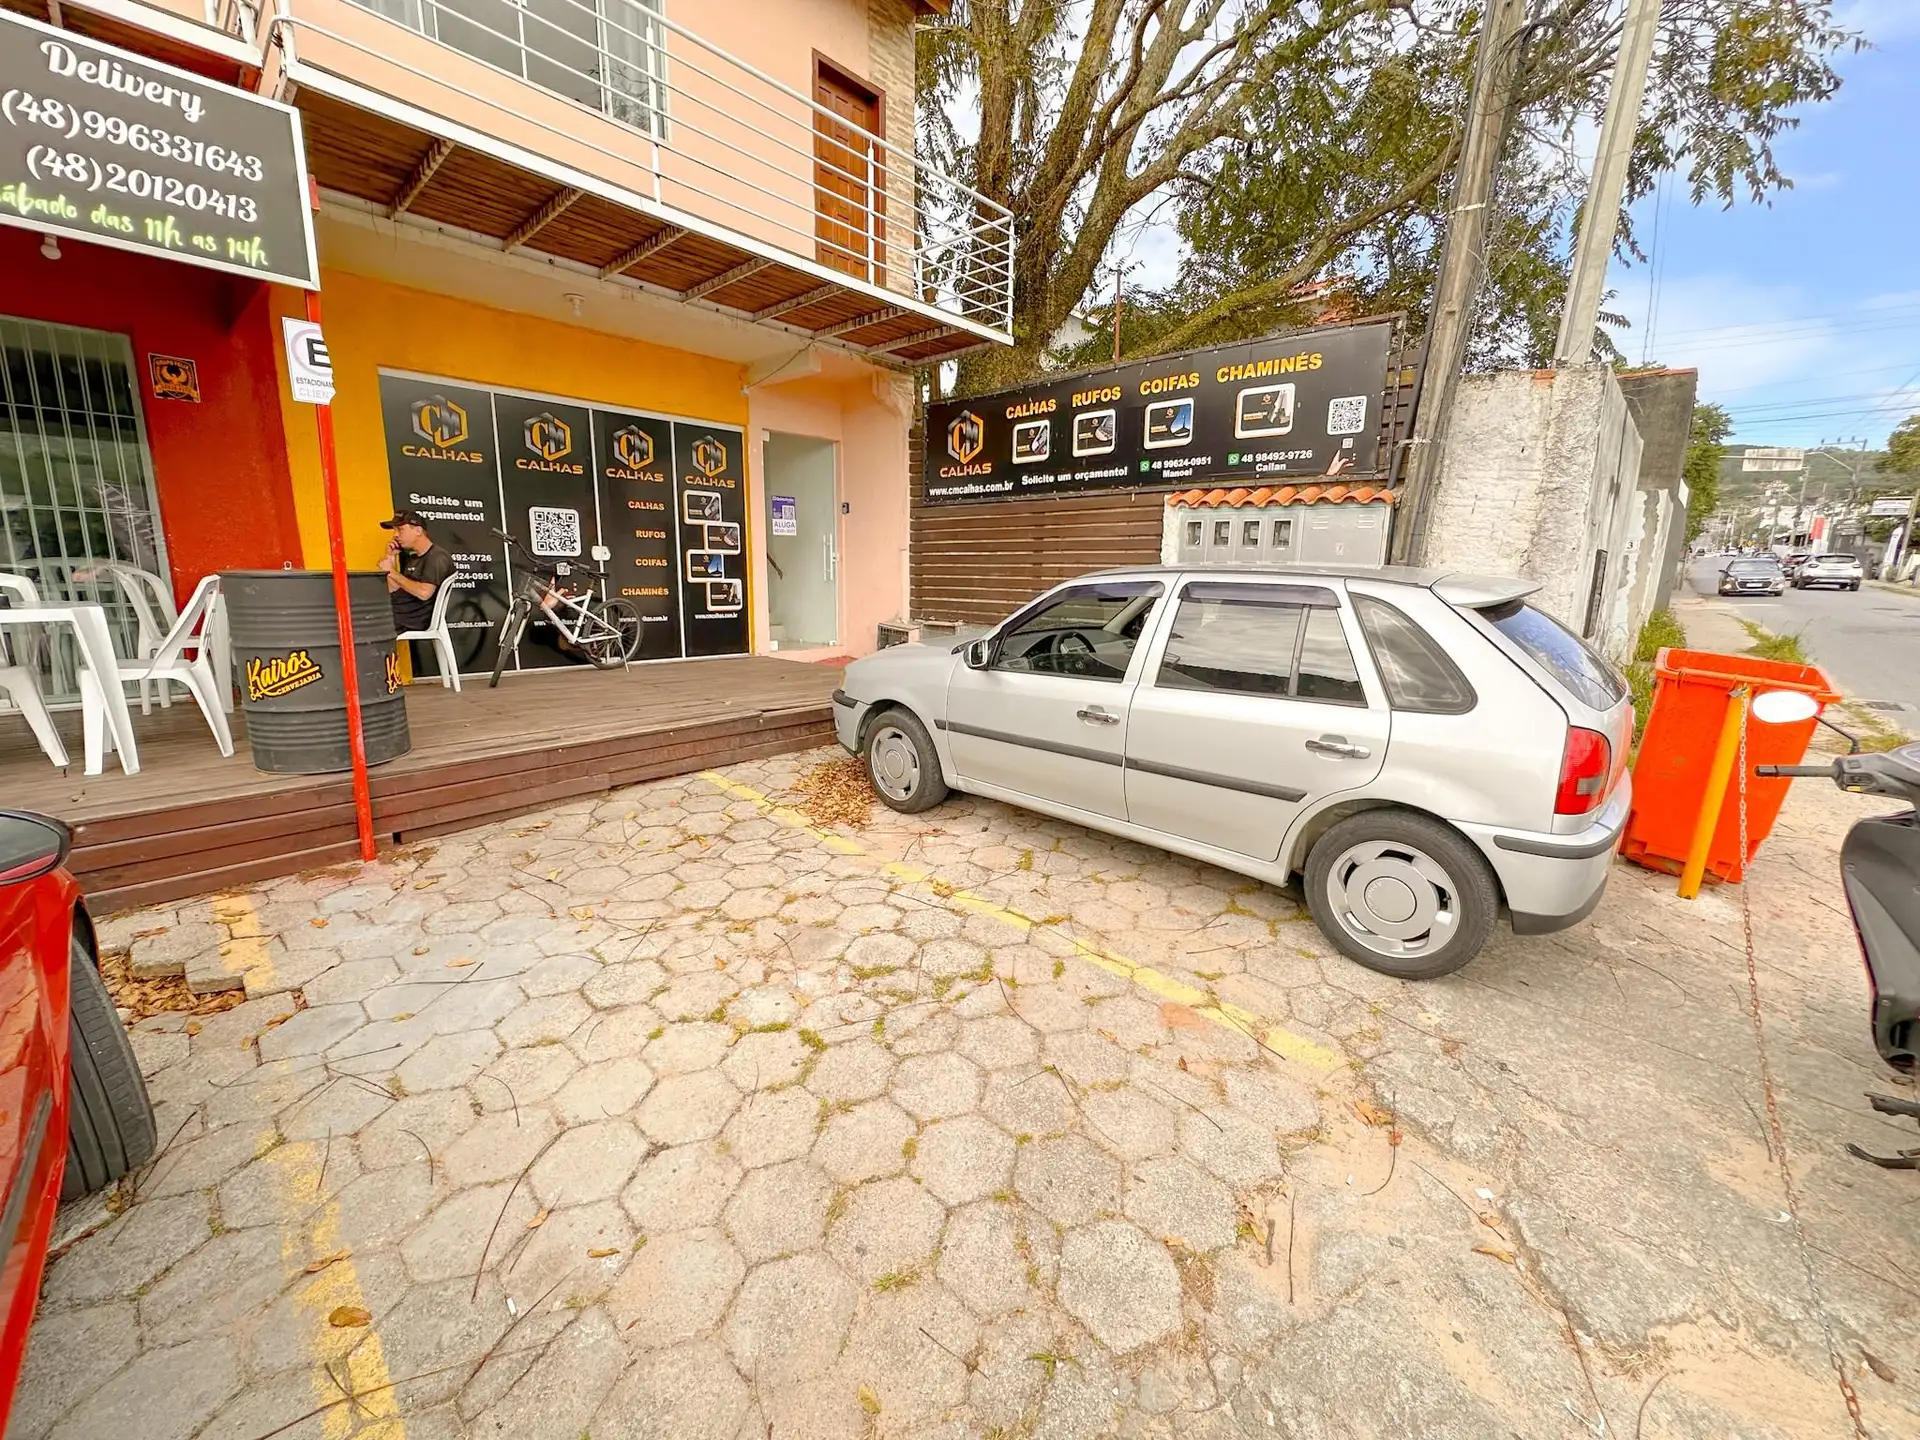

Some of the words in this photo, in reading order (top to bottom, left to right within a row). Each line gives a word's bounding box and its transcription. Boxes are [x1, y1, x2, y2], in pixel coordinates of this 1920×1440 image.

[40, 41, 206, 123] Delivery
[1, 89, 263, 182] (48)996331643
[26, 145, 258, 223] (48)20120413
[0, 182, 78, 219] ábado
[91, 203, 134, 233] das
[192, 234, 217, 252] as
[227, 236, 268, 267] 14h
[306, 338, 331, 367] E
[1216, 351, 1323, 383] CHAMINÉS
[1140, 372, 1200, 395] COIFAS
[1072, 386, 1122, 408] RUFOS
[1006, 399, 1057, 419] CALHAS
[402, 445, 483, 463] CALHAS
[1241, 453, 1253, 463] 48
[1255, 450, 1313, 462] 98492-9726
[516, 459, 584, 475] CALHAS
[940, 463, 992, 478] CALHAS
[1151, 461, 1162, 470] 48
[1163, 456, 1212, 468] 99624-0951
[606, 468, 664, 482] CALHAS
[1022, 475, 1054, 486] Solicite
[1057, 473, 1071, 482] um
[1075, 466, 1128, 481] orçamento!
[1163, 468, 1193, 478] Manoel
[685, 476, 736, 489] CALHAS
[929, 481, 1014, 496] www.cmcalhas.com.br
[410, 493, 460, 508] Solicite
[464, 500, 483, 508] um
[628, 501, 665, 510] CALHAS
[635, 530, 666, 539] RUFOS
[451, 553, 492, 562] 492-9726
[635, 558, 668, 567] COIFAS
[452, 581, 475, 589] anoel
[622, 586, 669, 596] CHAMINÉS
[247, 651, 312, 692] Kairós
[277, 672, 322, 695] CERVEJARIA
